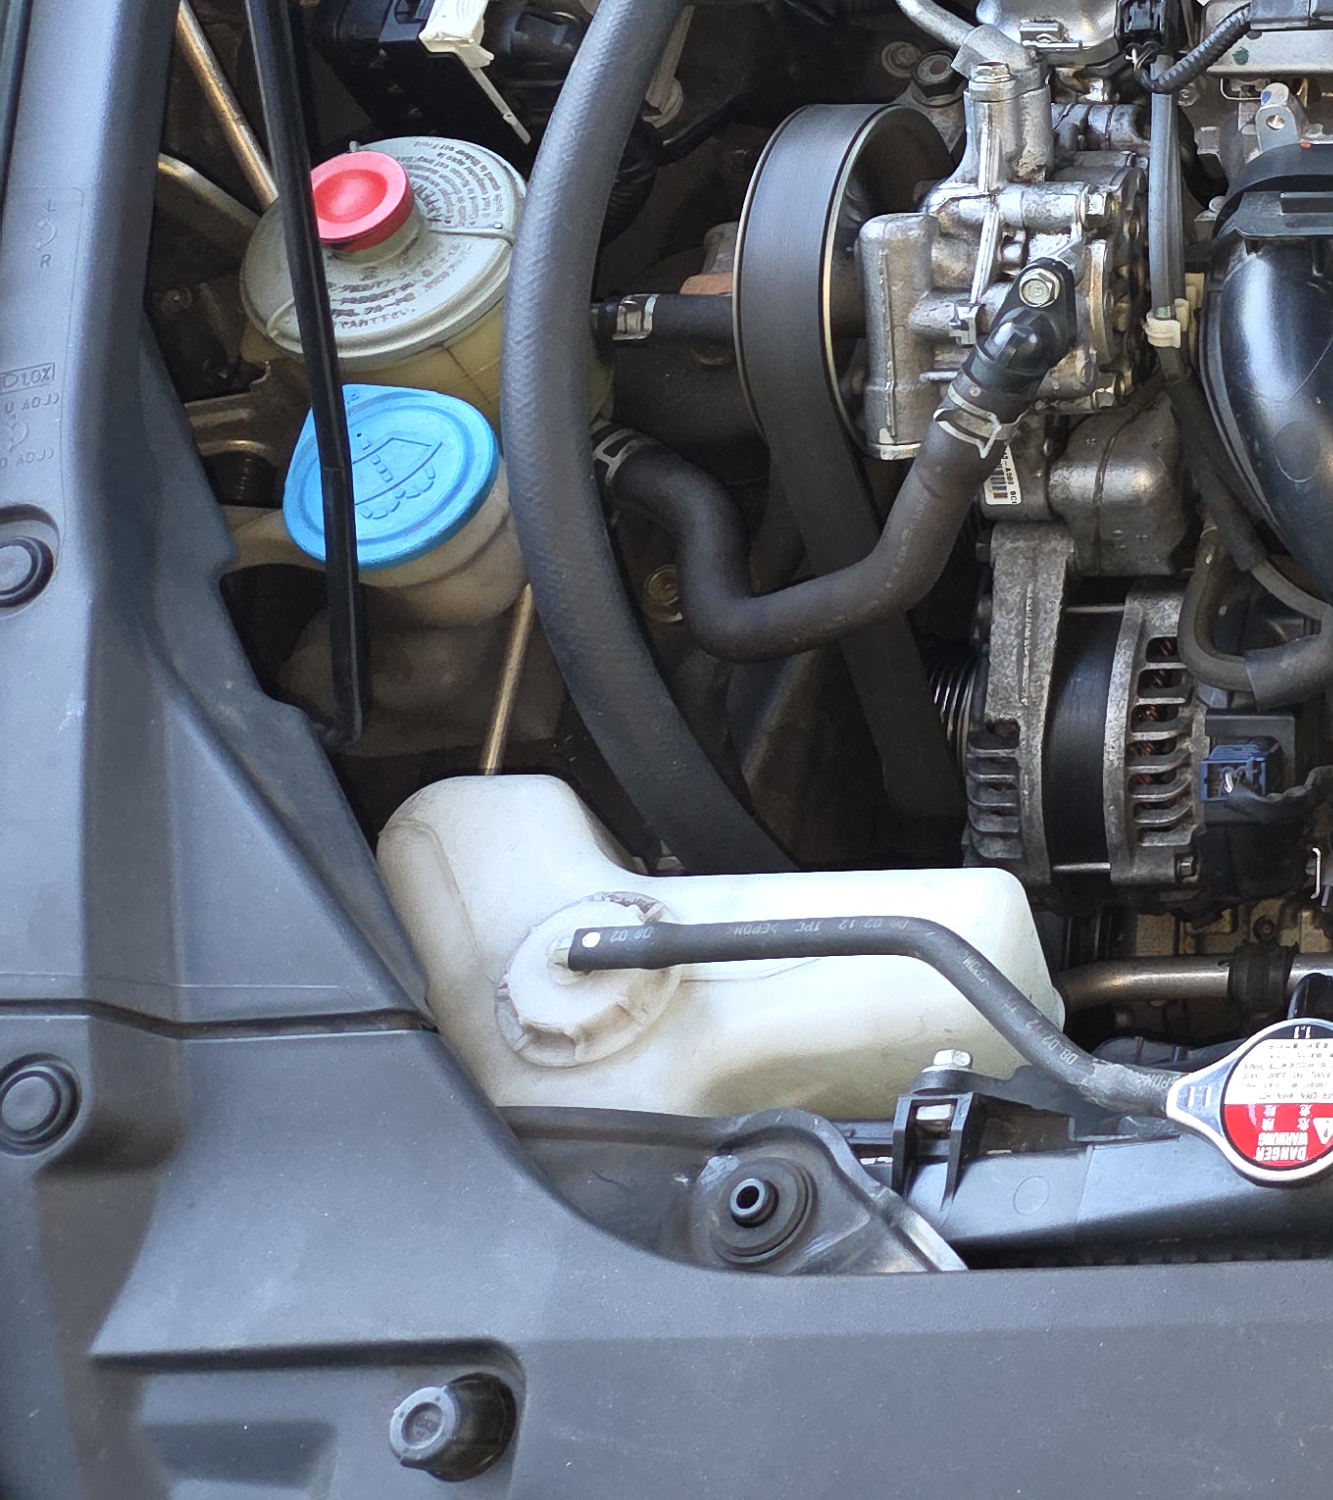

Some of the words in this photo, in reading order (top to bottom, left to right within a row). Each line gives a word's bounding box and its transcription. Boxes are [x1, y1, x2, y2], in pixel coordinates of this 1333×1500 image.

[40, 253, 52, 268] R
[1294, 1025, 1312, 1039] 1.1
[1258, 1131, 1308, 1146] WARNING
[1255, 1146, 1307, 1161] DANGER
